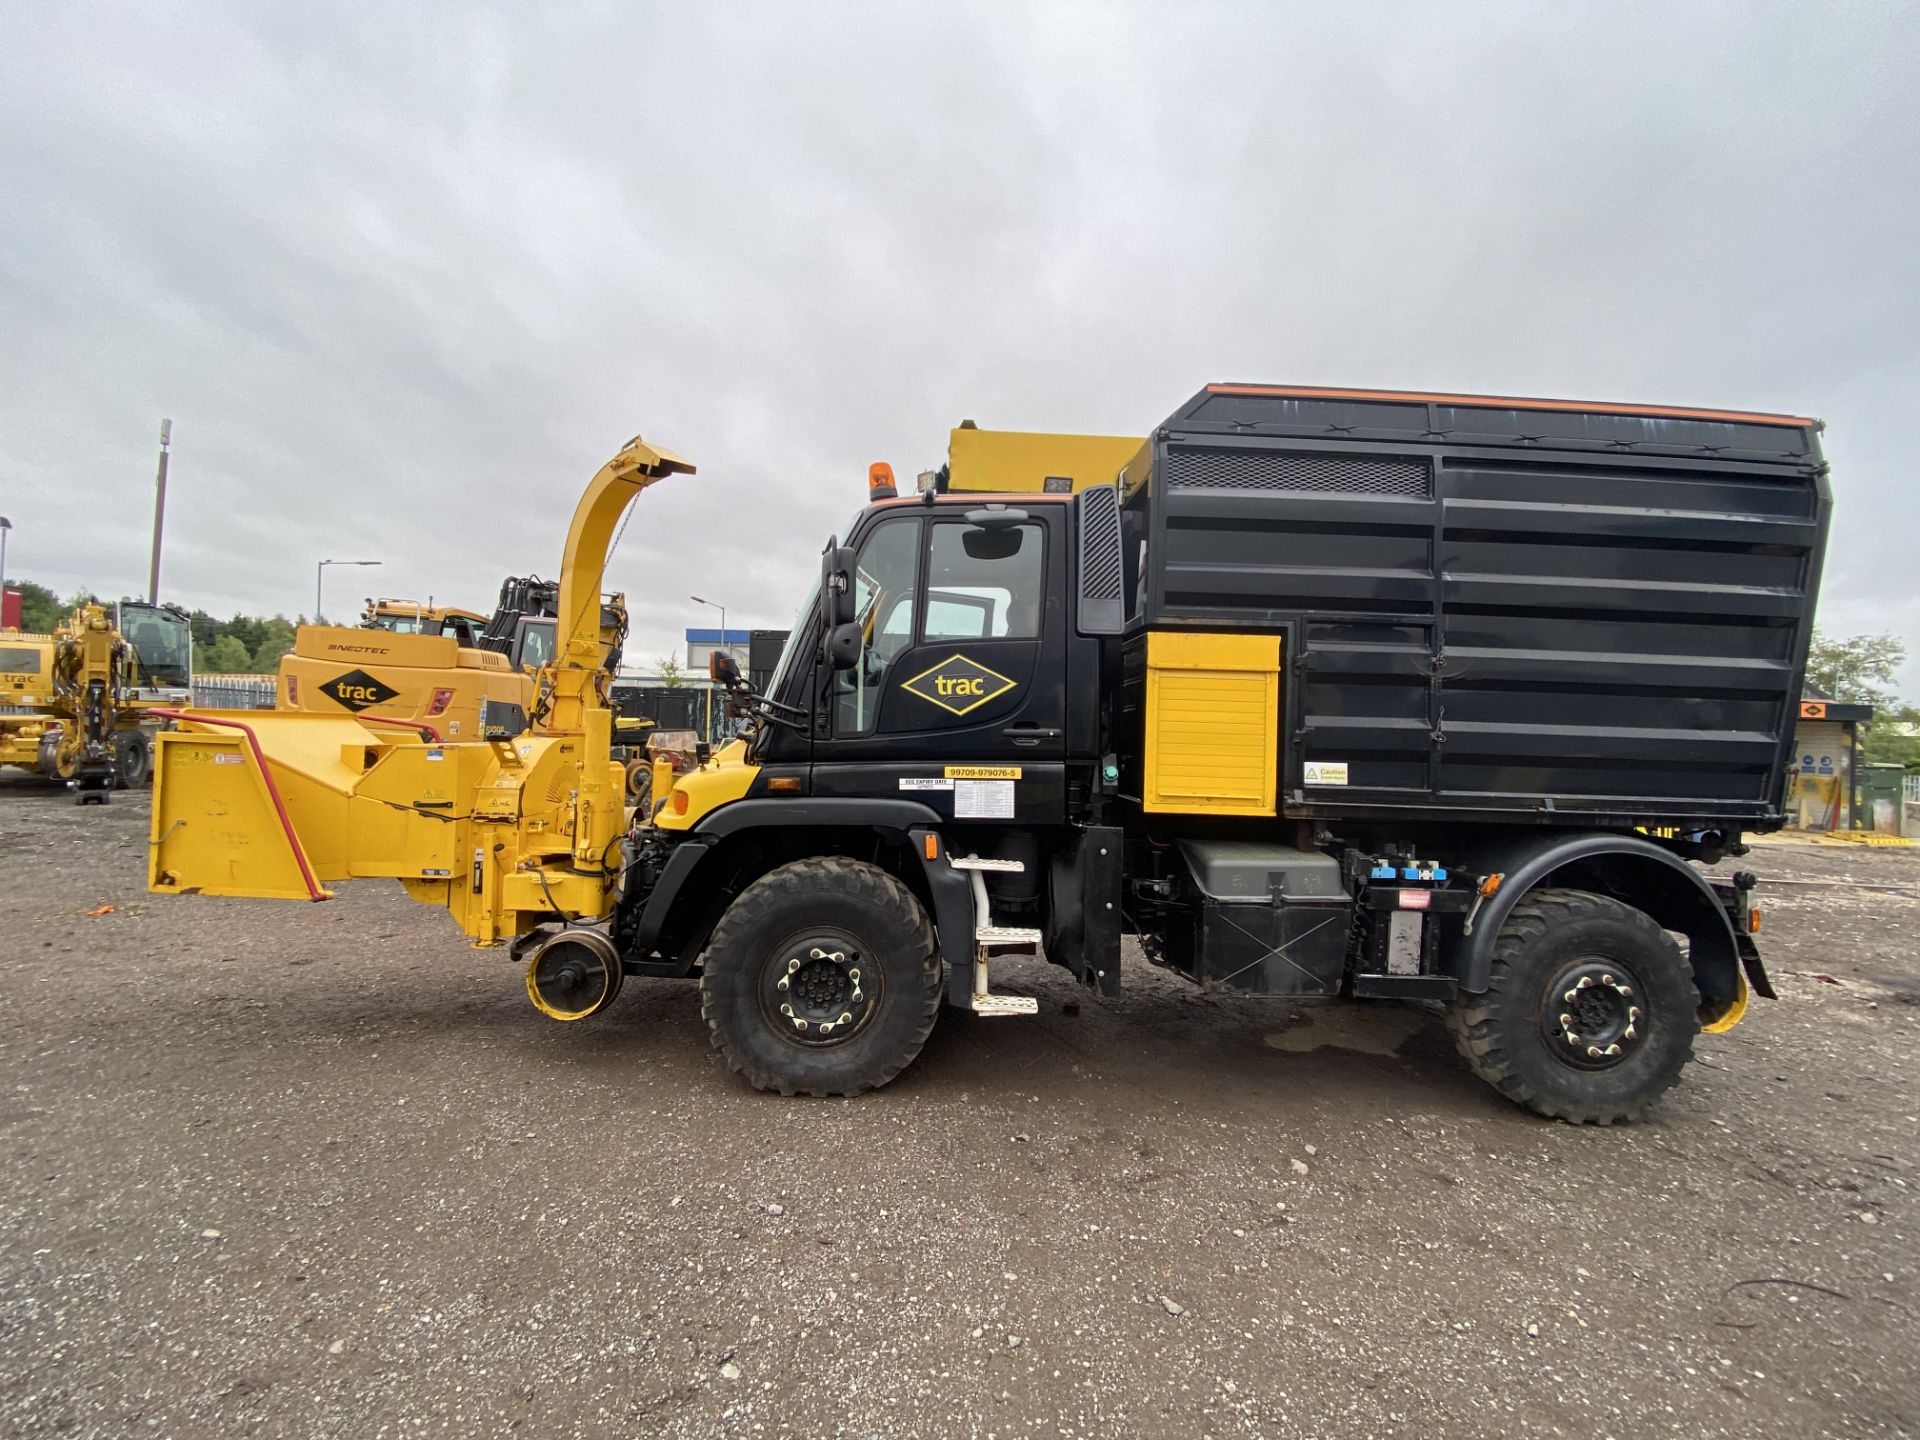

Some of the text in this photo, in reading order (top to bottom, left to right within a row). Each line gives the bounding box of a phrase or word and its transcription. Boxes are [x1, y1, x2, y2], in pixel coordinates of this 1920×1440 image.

[4, 674, 35, 683] trac
[935, 674, 984, 696] trac
[336, 682, 377, 700] trac
[950, 768, 1016, 777] 99709-979076-5
